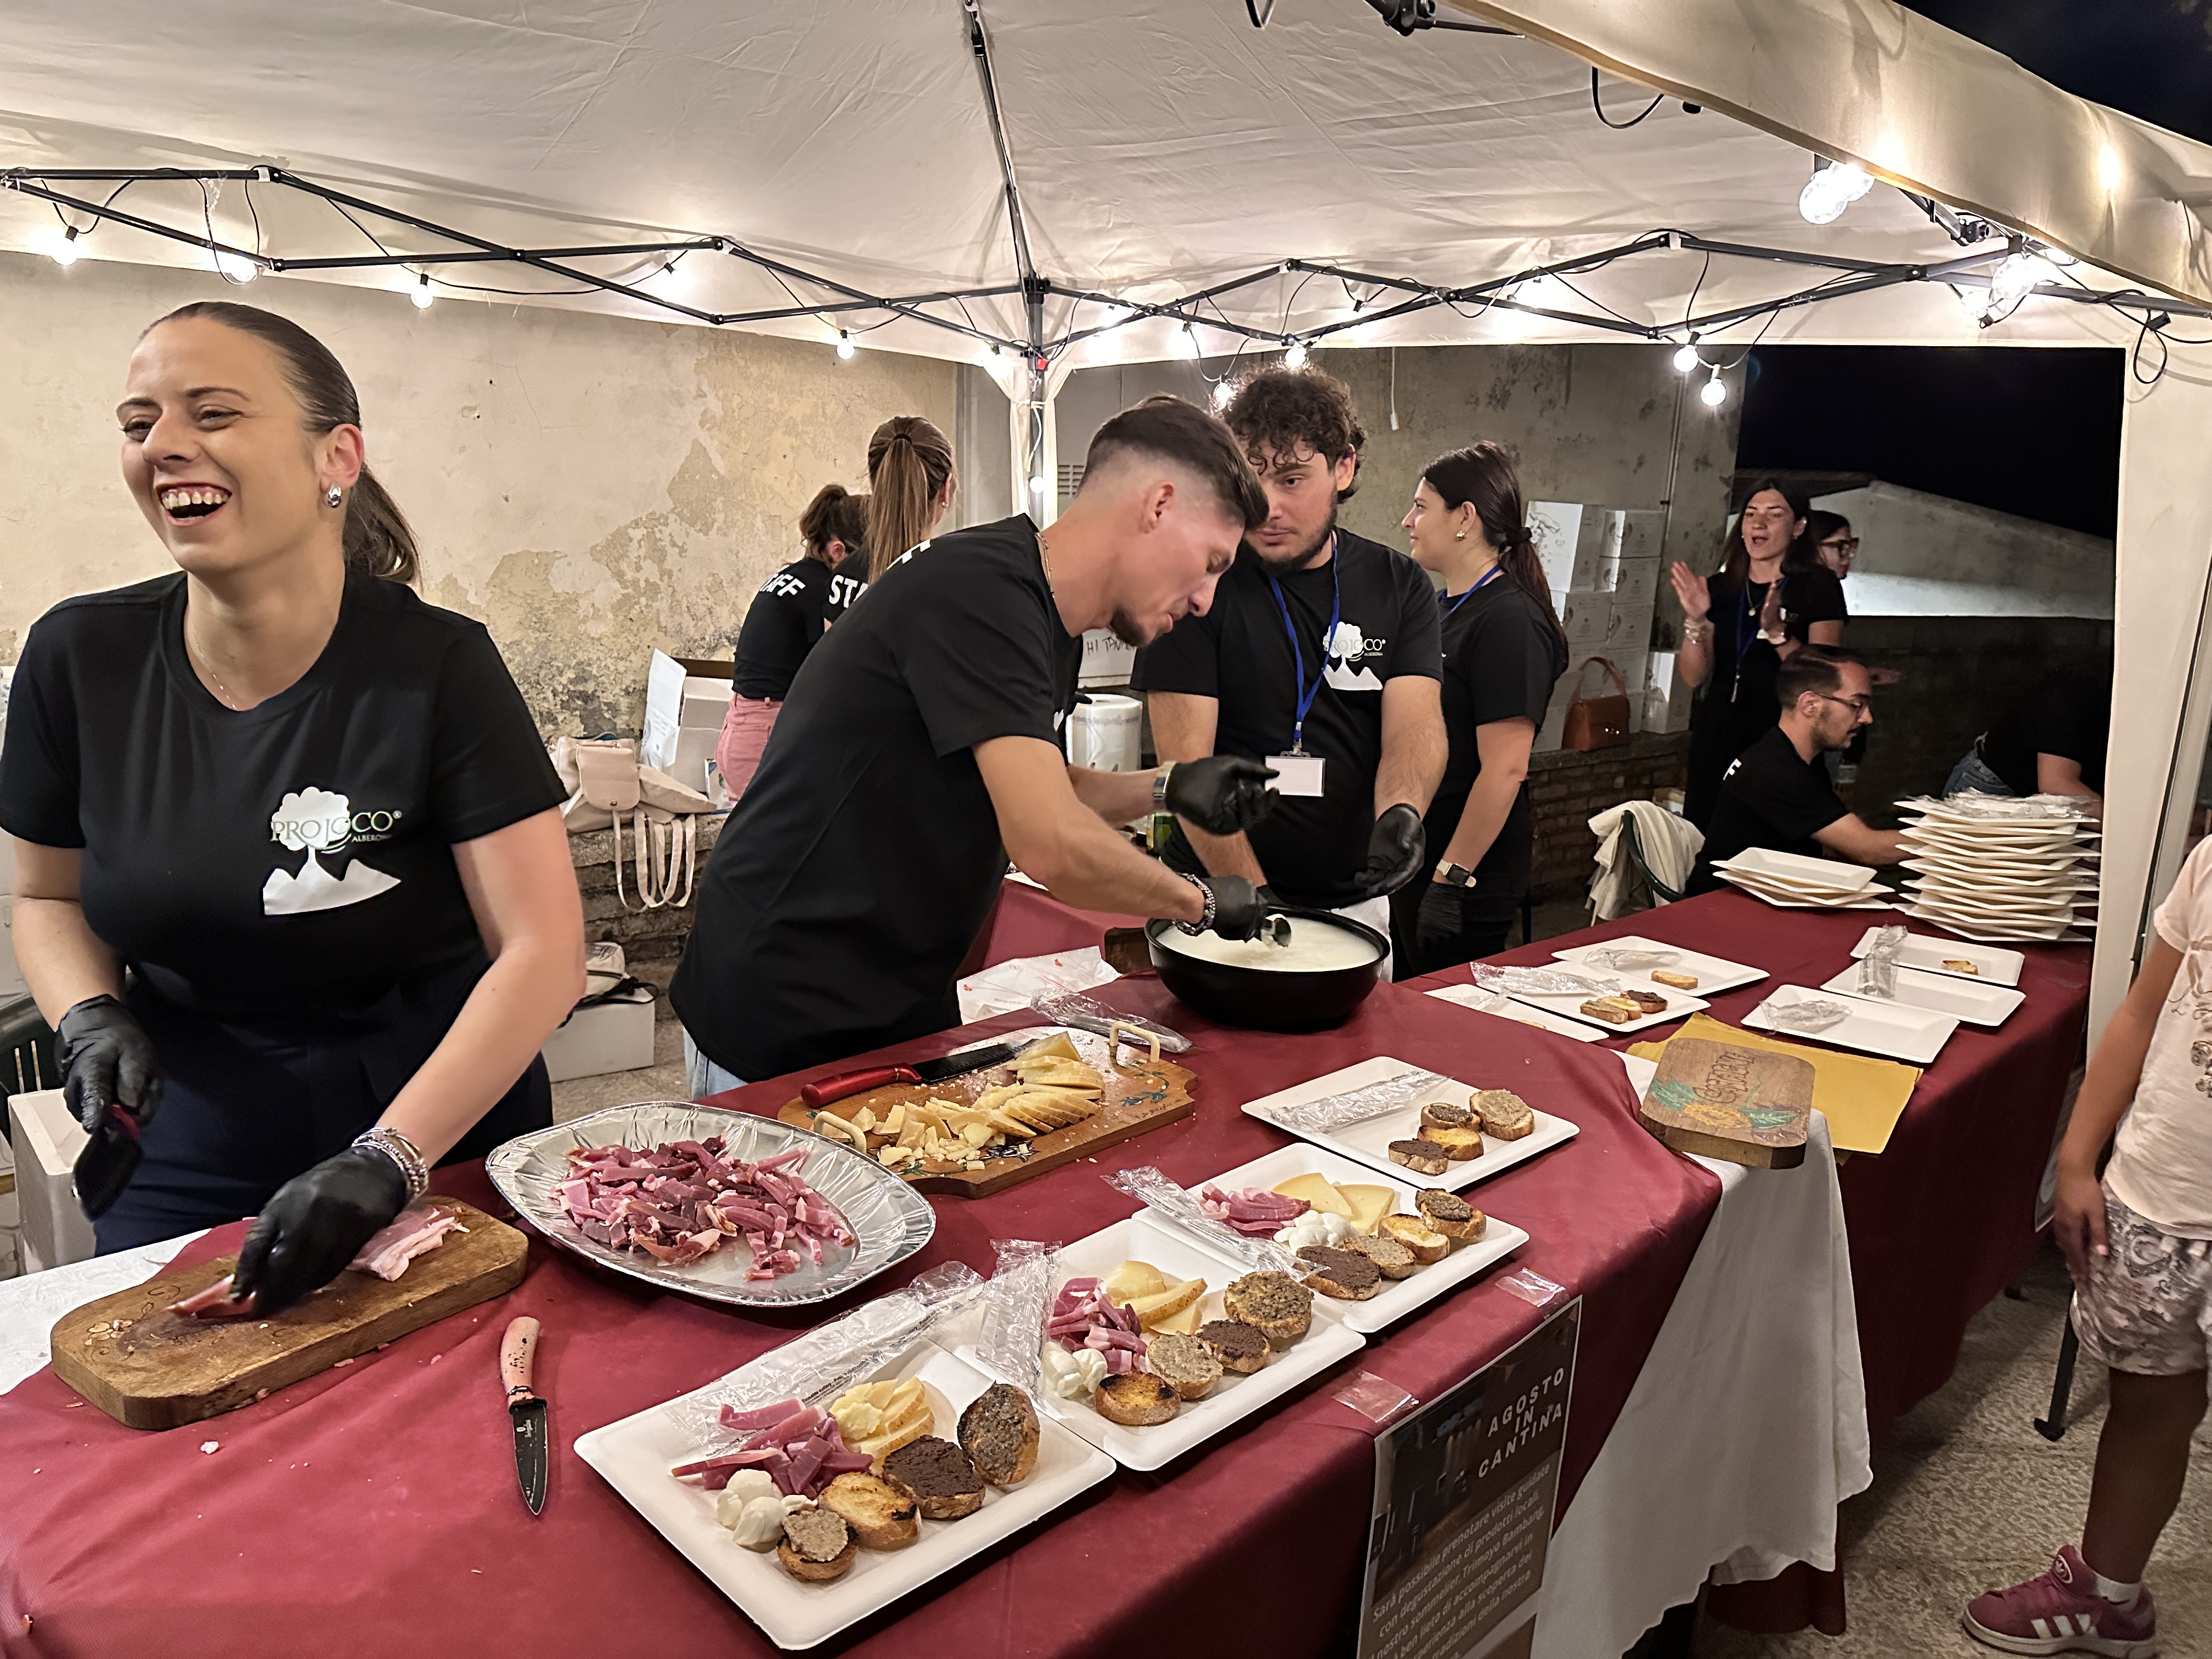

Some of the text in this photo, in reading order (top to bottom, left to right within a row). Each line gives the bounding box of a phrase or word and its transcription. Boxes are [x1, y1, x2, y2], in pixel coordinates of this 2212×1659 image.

[1479, 1403, 1561, 1478] CANTINA
[1487, 1367, 1564, 1437] AGOSTO
[1515, 1405, 1534, 1434] IN
[1373, 1464, 1550, 1623] Sarà possibile prenotare visite guidate
[1379, 1614, 1398, 1638] con
[1400, 1555, 1462, 1618] degustazione
[1464, 1541, 1474, 1558] di
[1475, 1509, 1514, 1554] prodotti
[1401, 1532, 1533, 1658] ben lieto di accompagnarvi in
[1478, 1596, 1500, 1621] della
[1501, 1570, 1531, 1601] nostra
[1377, 1624, 1408, 1659] nostro
[1463, 1542, 1500, 1578] Trimoyo
[1414, 1548, 1533, 1659] sperienza alla scoperta dei
